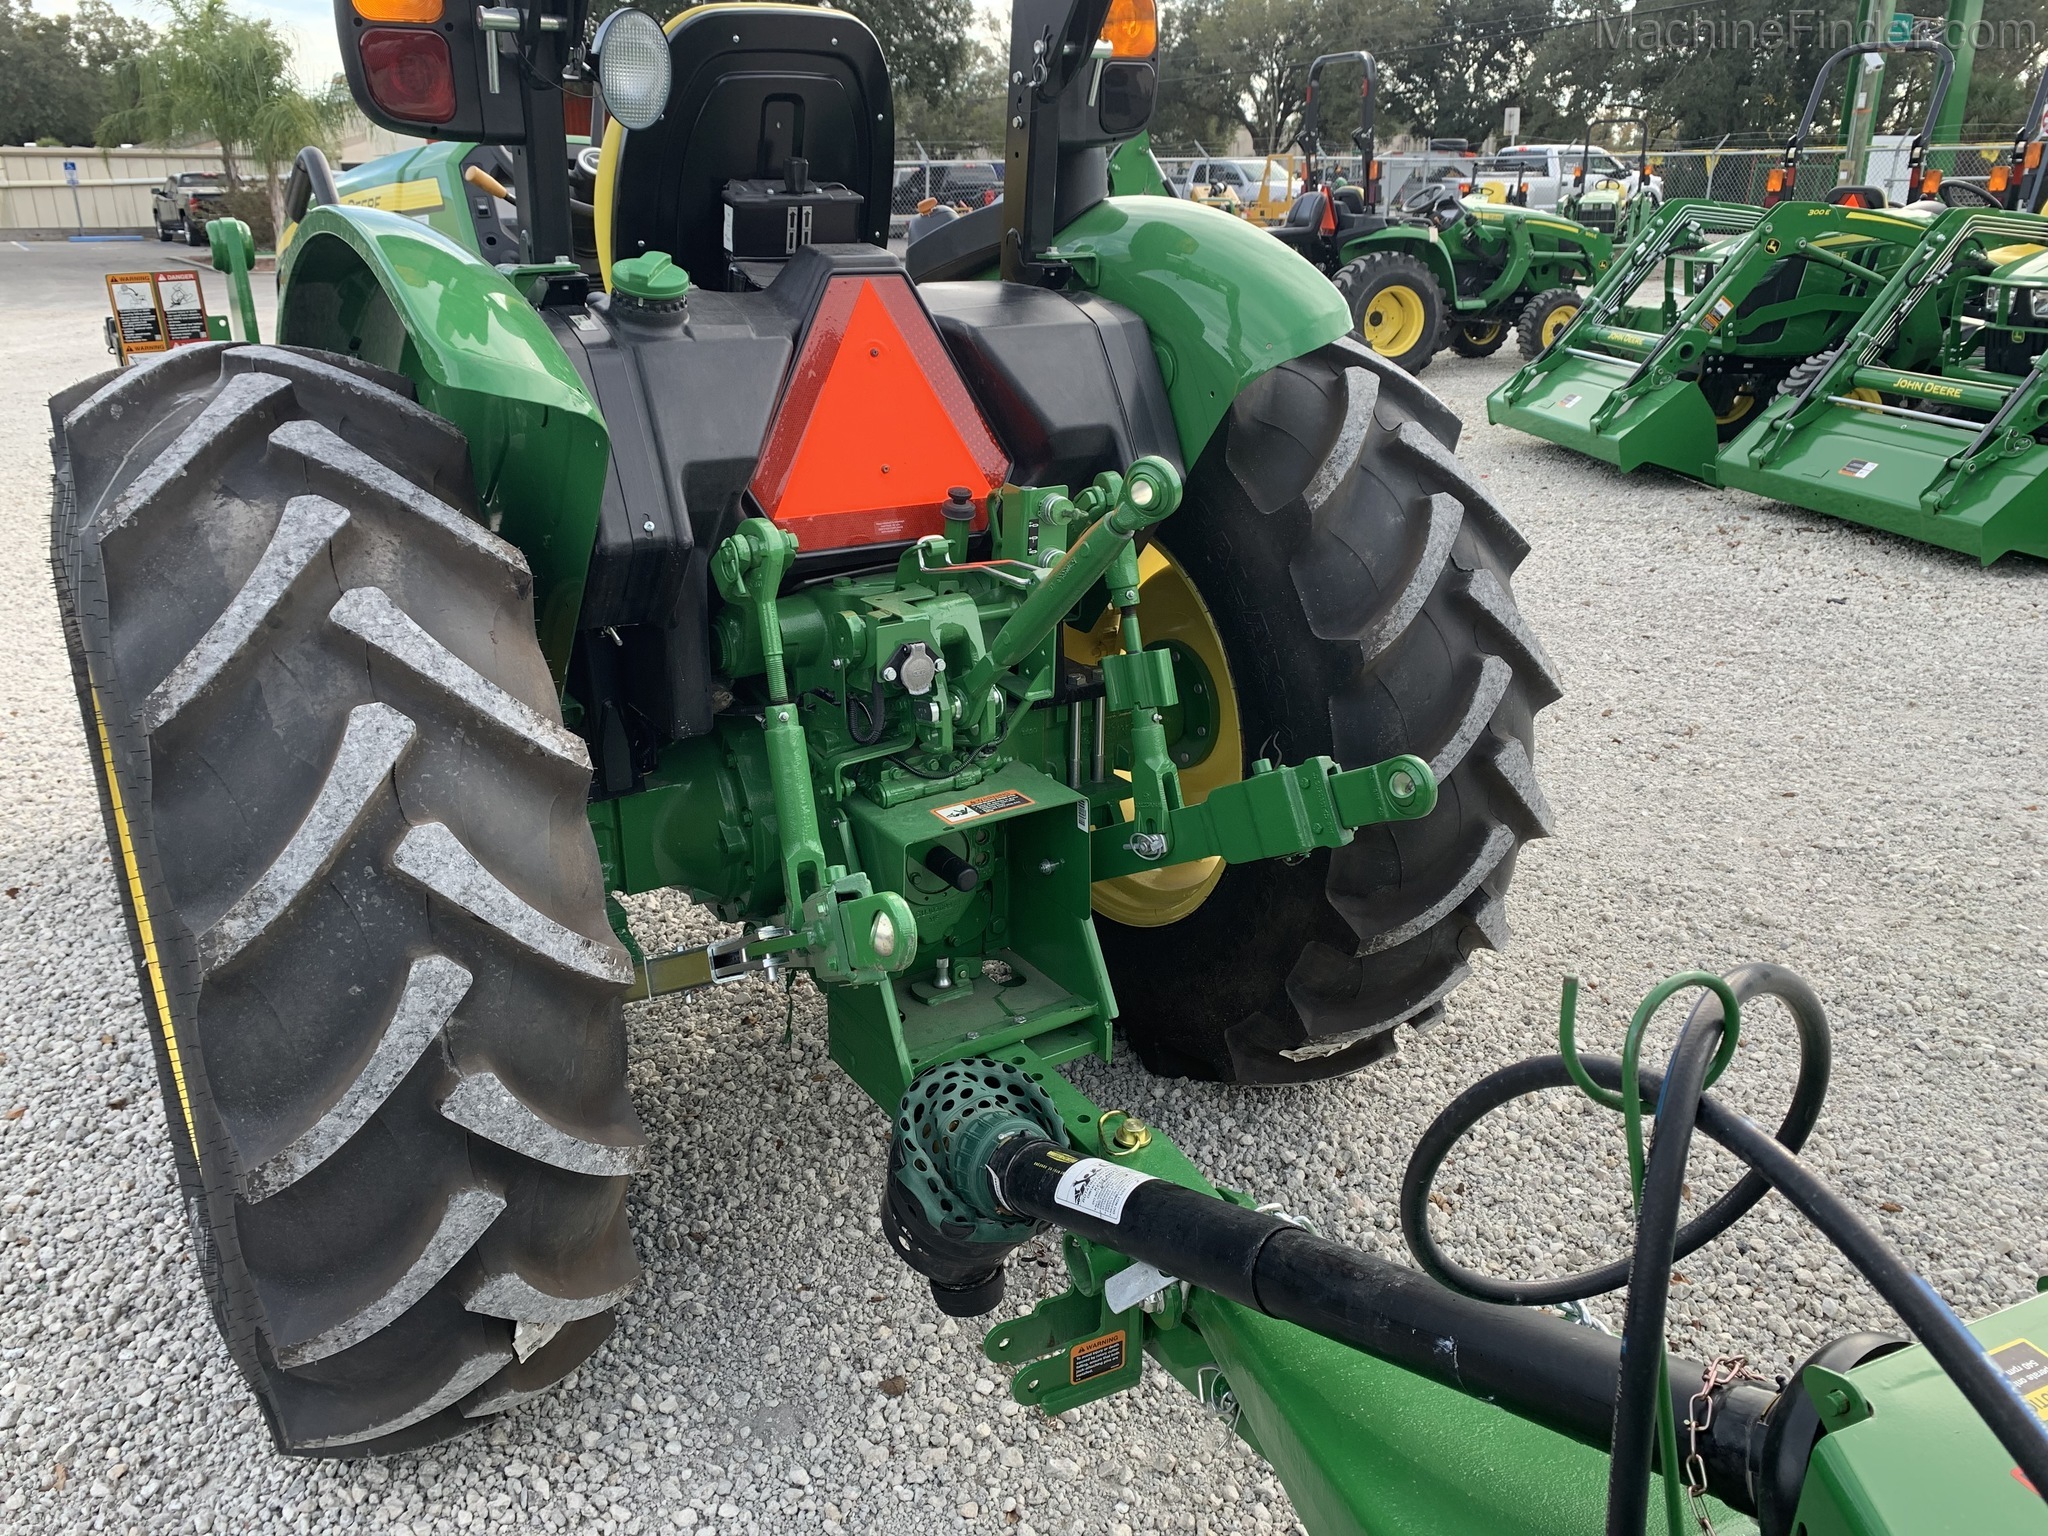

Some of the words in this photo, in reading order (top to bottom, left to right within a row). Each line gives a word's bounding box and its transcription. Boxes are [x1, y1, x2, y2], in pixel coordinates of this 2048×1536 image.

[1607, 330, 1623, 342] JOHN
[1624, 333, 1644, 346] DEERE
[1893, 377, 1923, 391] JOHN
[1924, 382, 1963, 398] DEERE
[1086, 1335, 1118, 1350] WARNING
[2004, 1365, 2024, 1376] rpm
[2021, 1359, 2040, 1370] 540
[2025, 1365, 2048, 1381] perate
[2012, 1377, 2028, 1388] onl
